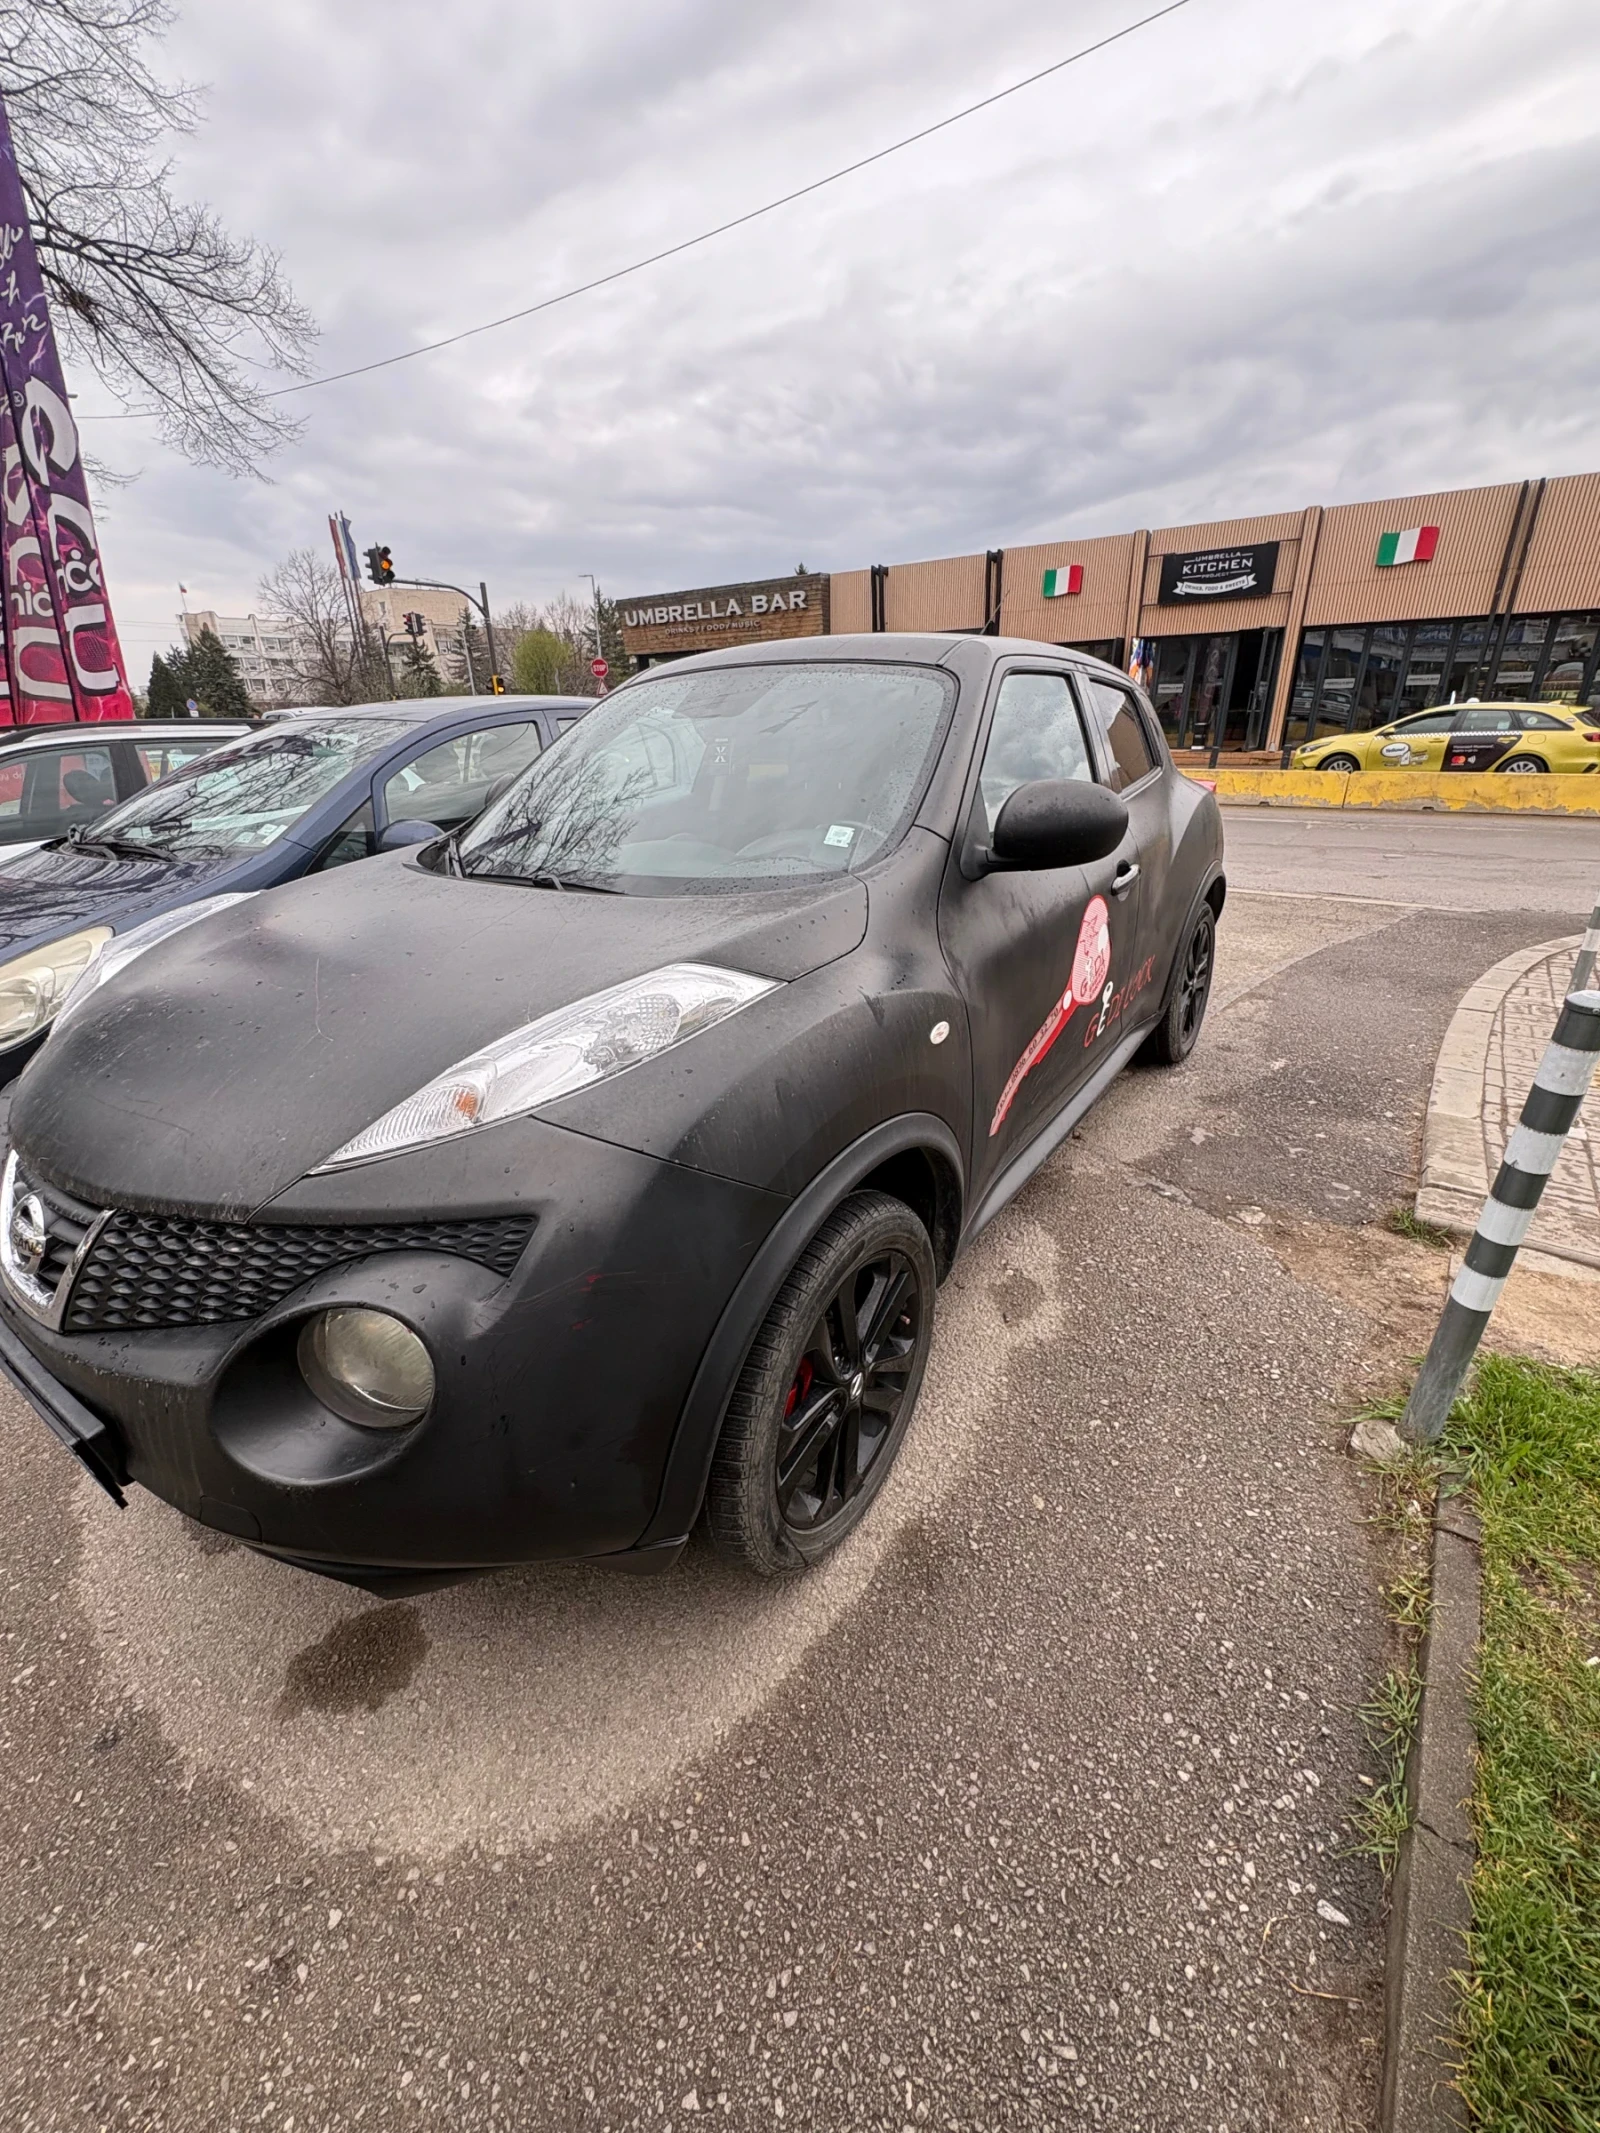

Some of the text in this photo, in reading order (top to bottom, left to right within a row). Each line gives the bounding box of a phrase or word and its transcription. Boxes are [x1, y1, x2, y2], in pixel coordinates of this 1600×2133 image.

[1195, 551, 1242, 562] UMBRELLA
[1182, 558, 1254, 575] KITCHEN
[624, 590, 809, 628] UMBRELLA BAR
[593, 664, 607, 672] STOP
